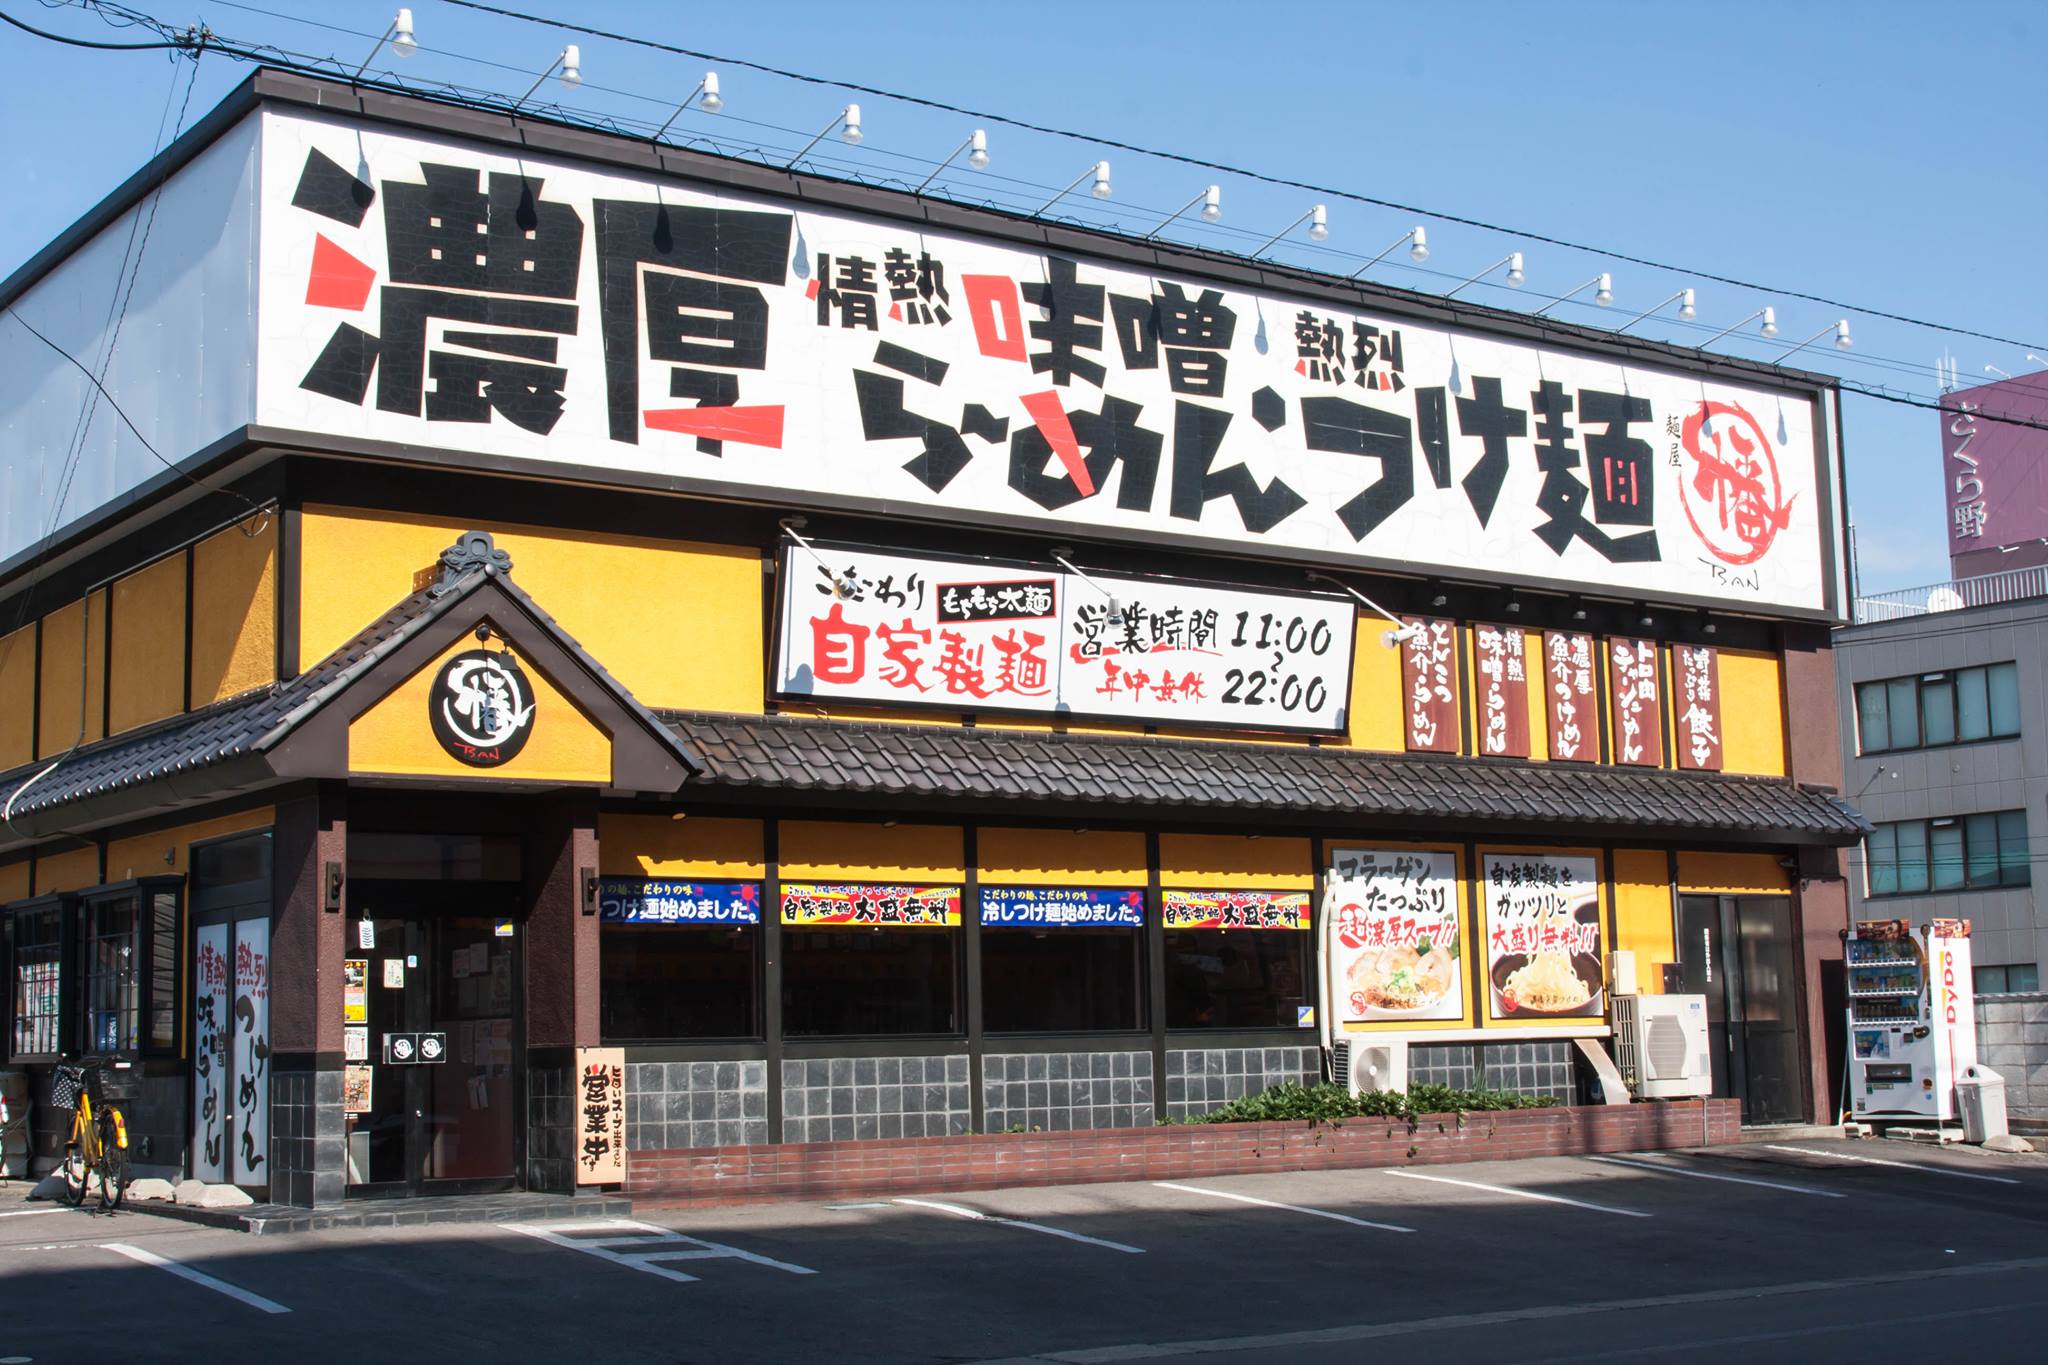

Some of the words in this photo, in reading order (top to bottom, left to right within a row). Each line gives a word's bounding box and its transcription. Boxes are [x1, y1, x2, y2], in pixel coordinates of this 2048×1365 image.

[292, 146, 793, 458] 濃厚
[805, 247, 953, 332] 情熱
[961, 256, 1238, 398] 味噌
[1293, 308, 1407, 393] 熱烈
[1949, 401, 1987, 539] さくら野
[942, 584, 1053, 620] もちもち太麺
[1073, 600, 1219, 656] 営業時間
[809, 602, 1052, 700] 自家製麺
[1230, 610, 1332, 657] 11:00
[1504, 630, 1525, 683] 情熱
[1096, 658, 1209, 704] 年中無休
[1221, 668, 1328, 714] 22:00
[1479, 630, 1507, 753] 味噌らーめん
[1570, 636, 1594, 696] 濃厚
[1549, 634, 1582, 760] 魚介つけめん
[1680, 702, 1719, 768] 餃子
[1338, 854, 1432, 888] コラーゲン
[1490, 861, 1574, 890] 自家製麺を
[599, 898, 757, 924] つけ麺始めました。
[982, 901, 1142, 924] 冷しつけ麺始めました。
[1365, 886, 1446, 914] たっぷり
[1496, 891, 1569, 919] ガッツリと
[198, 939, 227, 996] 情熱
[236, 938, 268, 999] 熱烈
[236, 994, 266, 1173] つけめん
